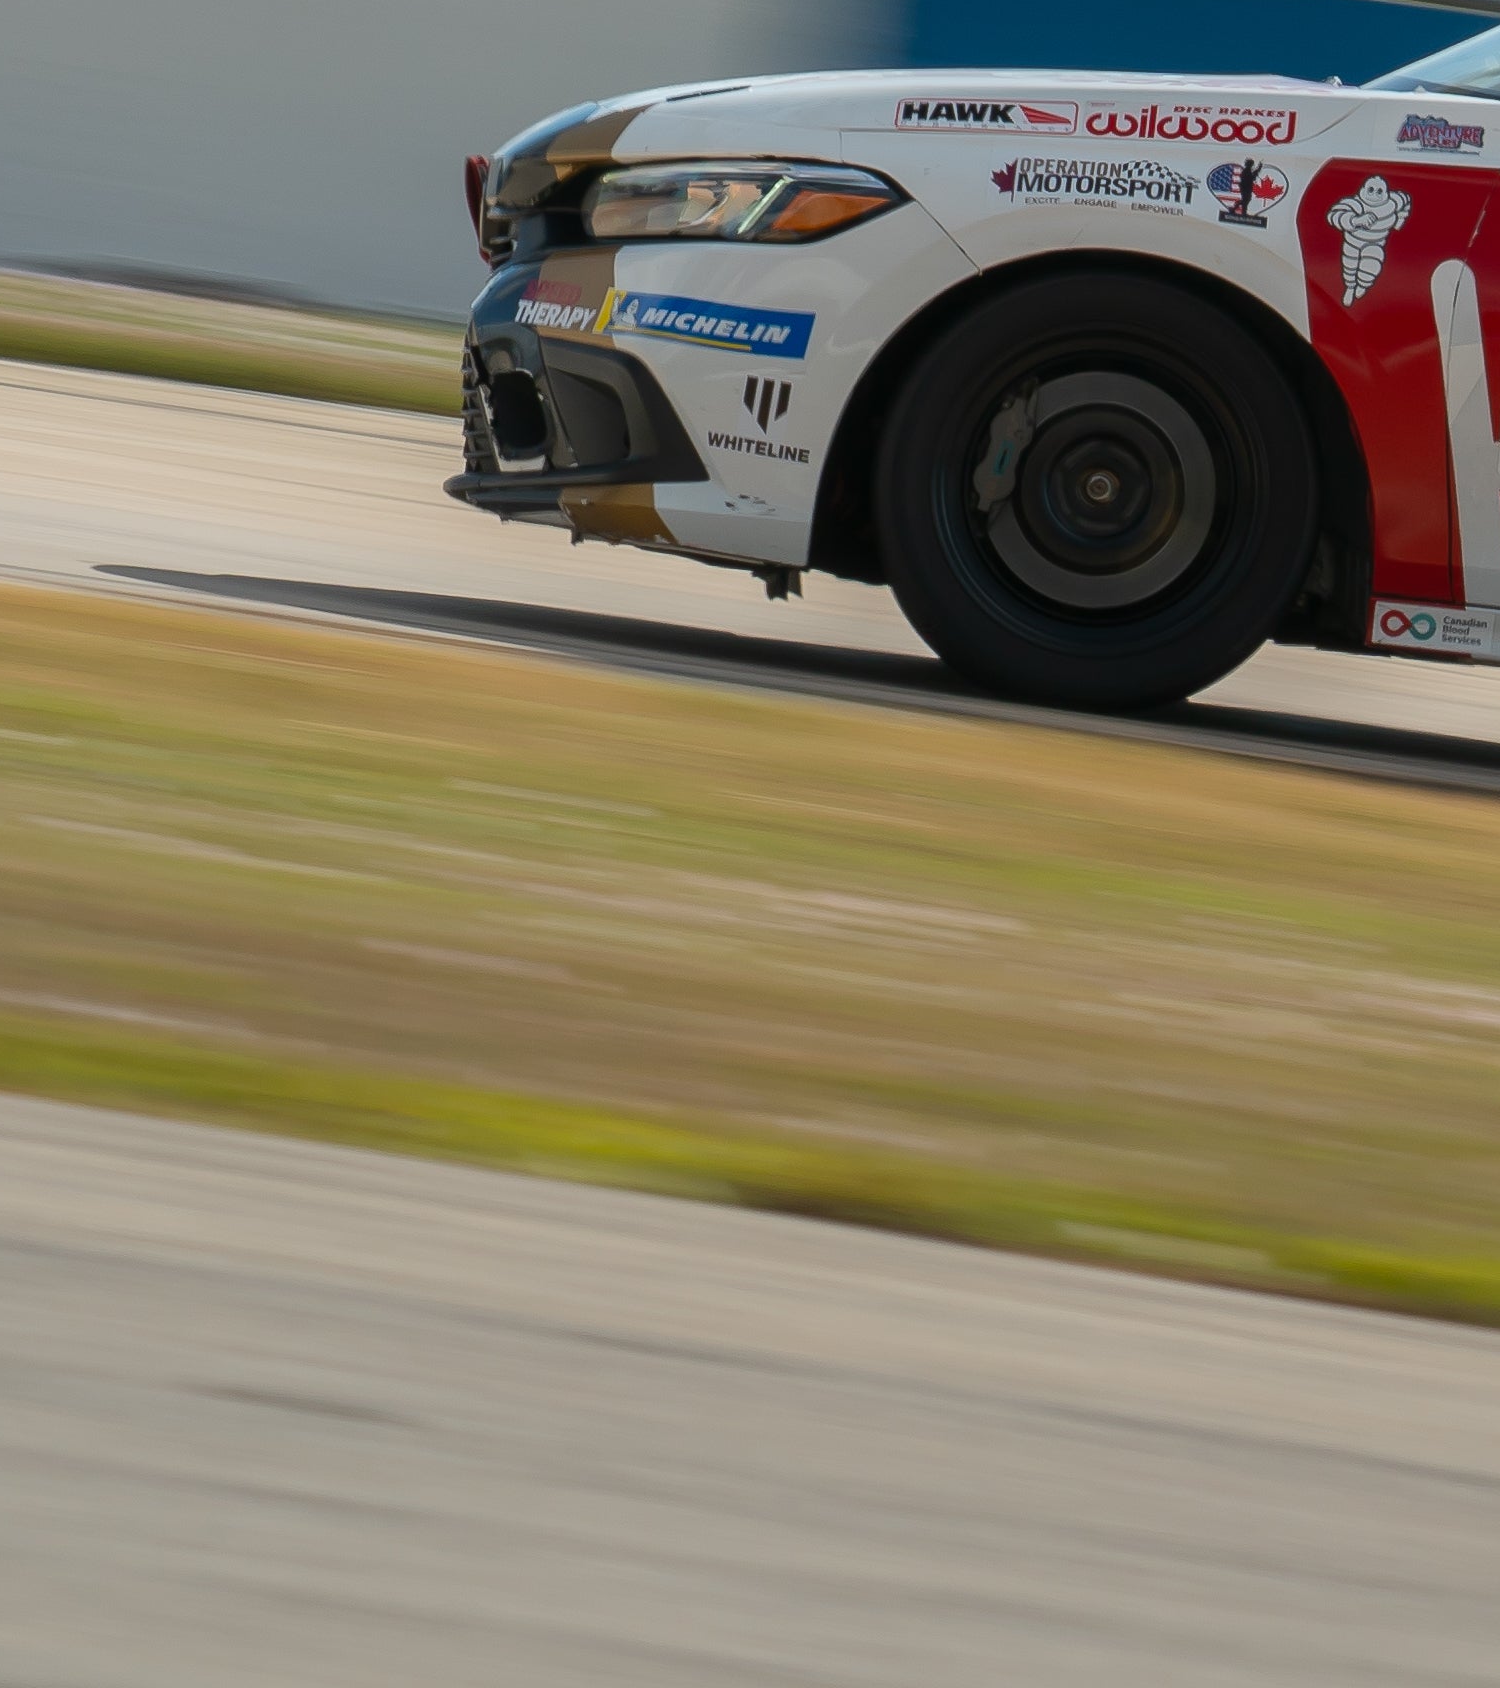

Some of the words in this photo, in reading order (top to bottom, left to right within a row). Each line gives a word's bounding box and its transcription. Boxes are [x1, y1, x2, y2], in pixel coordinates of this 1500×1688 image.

[902, 102, 1017, 124] HAWK
[1174, 105, 1212, 114] DISC
[1219, 107, 1287, 118] BRAKES
[1085, 104, 1298, 146] wilwood
[1019, 157, 1122, 177] OPERATION
[1016, 173, 1196, 204] MOTORSPORT
[1024, 196, 1061, 205] EXCITE
[1073, 198, 1118, 209] ENGAGE
[1130, 202, 1185, 217] EMPOWER
[514, 298, 598, 332] THERAPY
[641, 307, 792, 345] MICHELIN
[707, 431, 810, 463] WHITELINE
[1442, 625, 1470, 635] Blood
[1443, 616, 1488, 629] Canadian
[1442, 634, 1482, 646] Services
